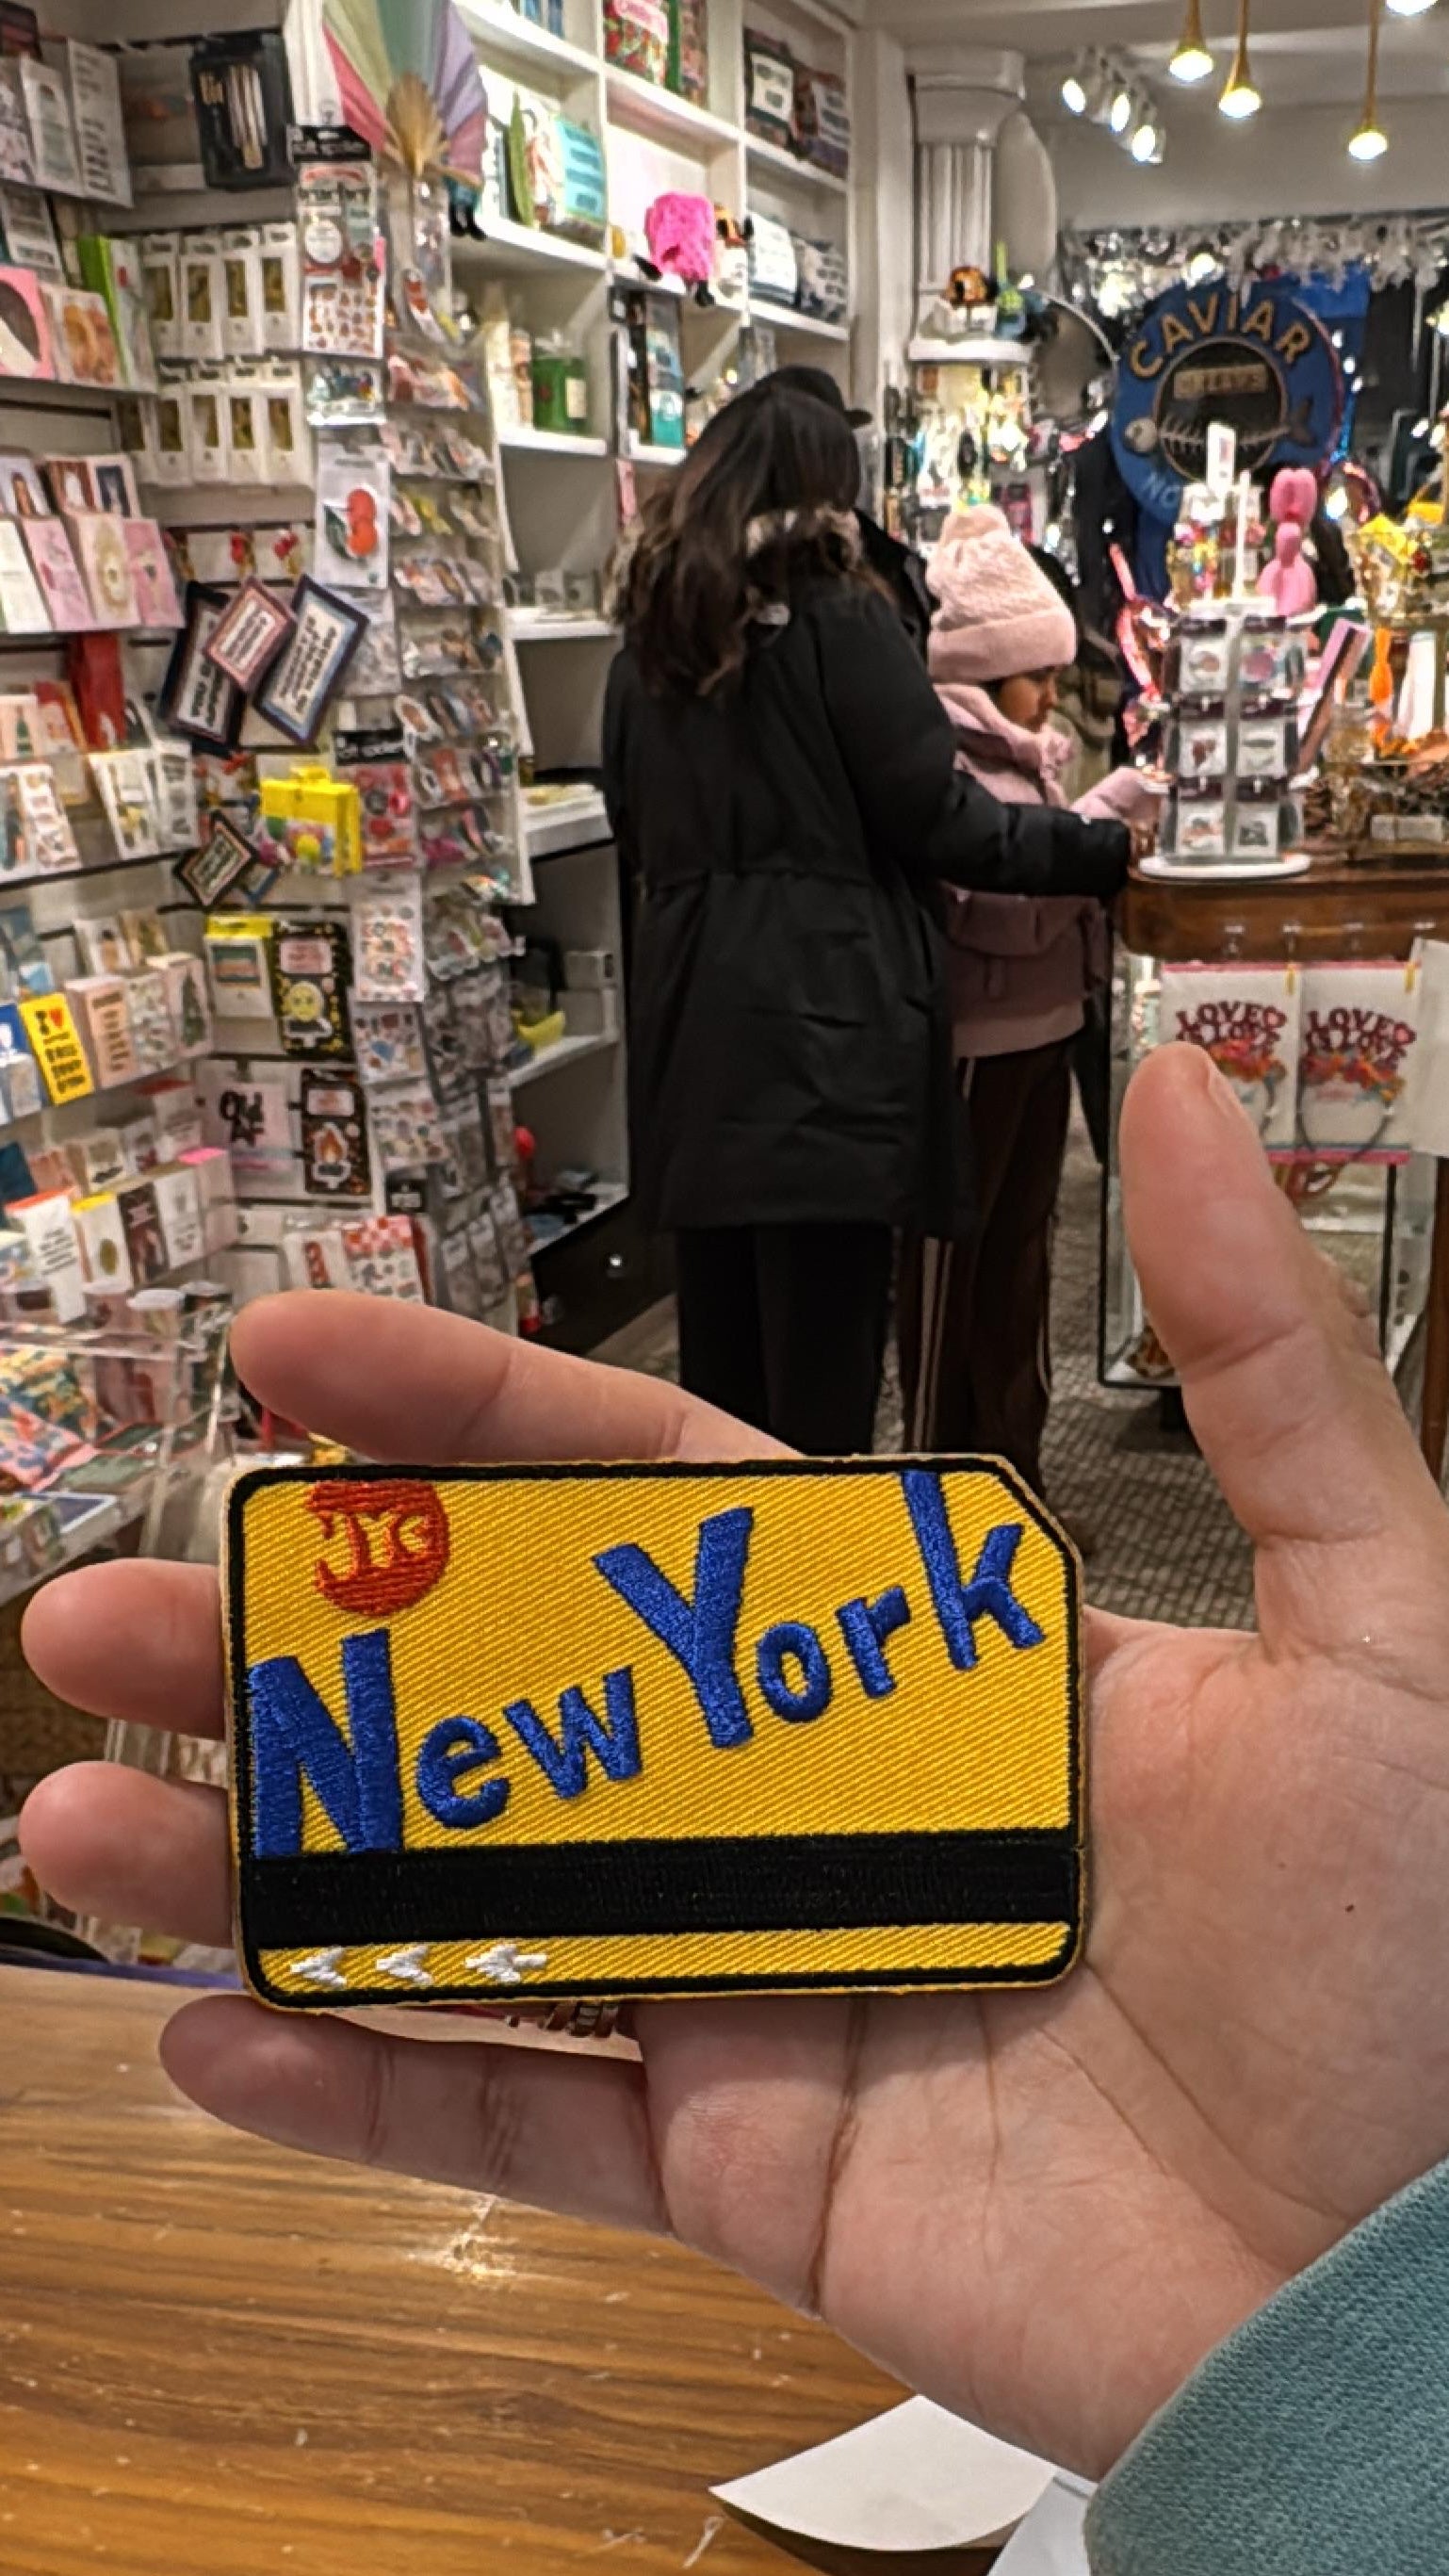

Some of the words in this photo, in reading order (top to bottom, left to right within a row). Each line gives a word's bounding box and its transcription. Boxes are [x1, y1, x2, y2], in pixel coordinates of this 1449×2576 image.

[1129, 291, 1312, 379] CAVIAR
[248, 1628, 642, 1860] New
[591, 1470, 1049, 1750] York
